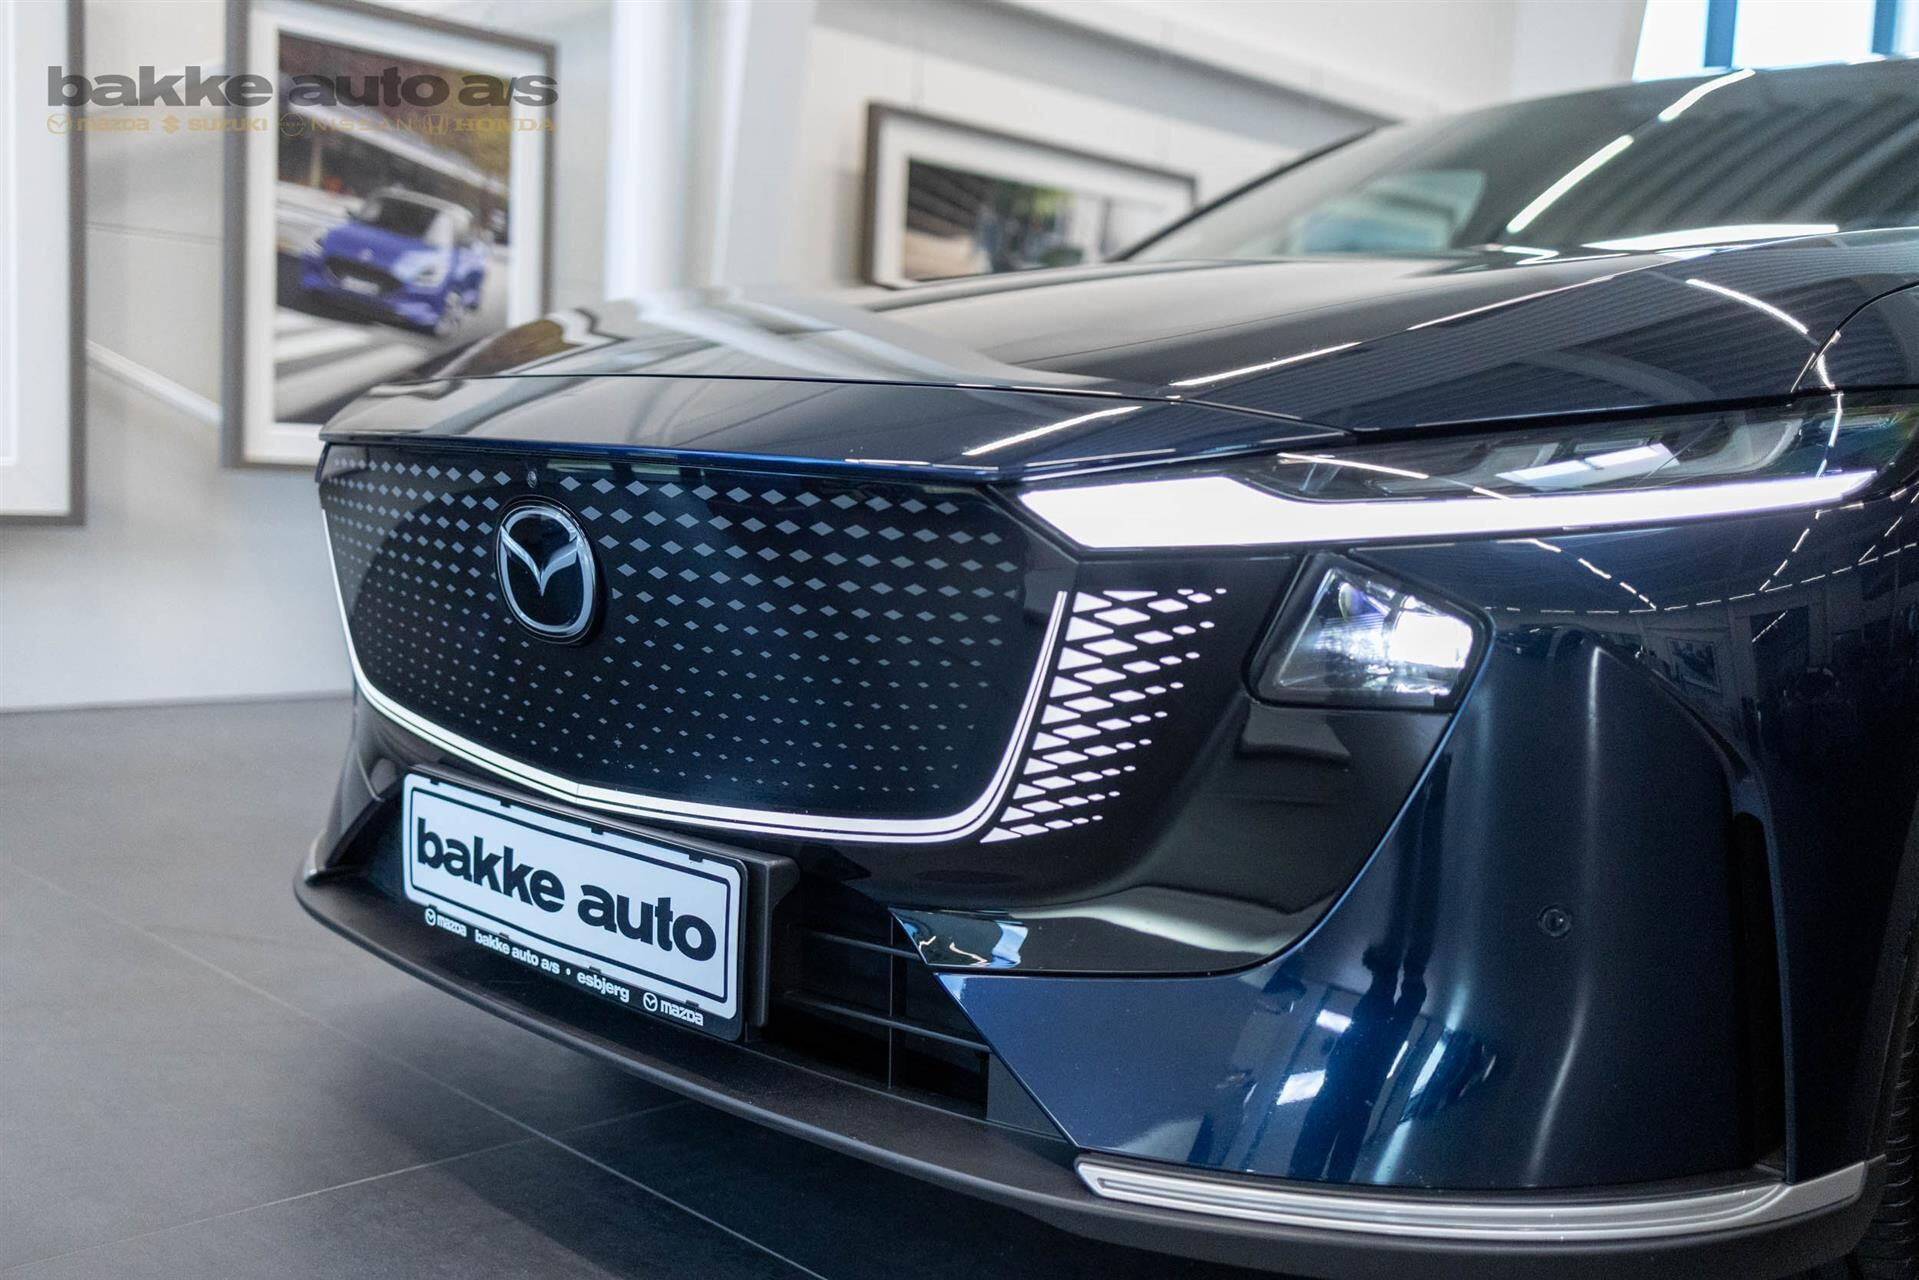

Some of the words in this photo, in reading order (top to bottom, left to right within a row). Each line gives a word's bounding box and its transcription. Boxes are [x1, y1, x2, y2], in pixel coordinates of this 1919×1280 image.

[416, 817, 565, 913] bakke
[577, 884, 717, 961] auto
[436, 914, 467, 937] mazda
[474, 929, 510, 954] bakke
[511, 946, 539, 966] auto
[540, 958, 560, 974] a/s
[576, 971, 630, 1003] esbjerg
[660, 999, 704, 1027] mazda
